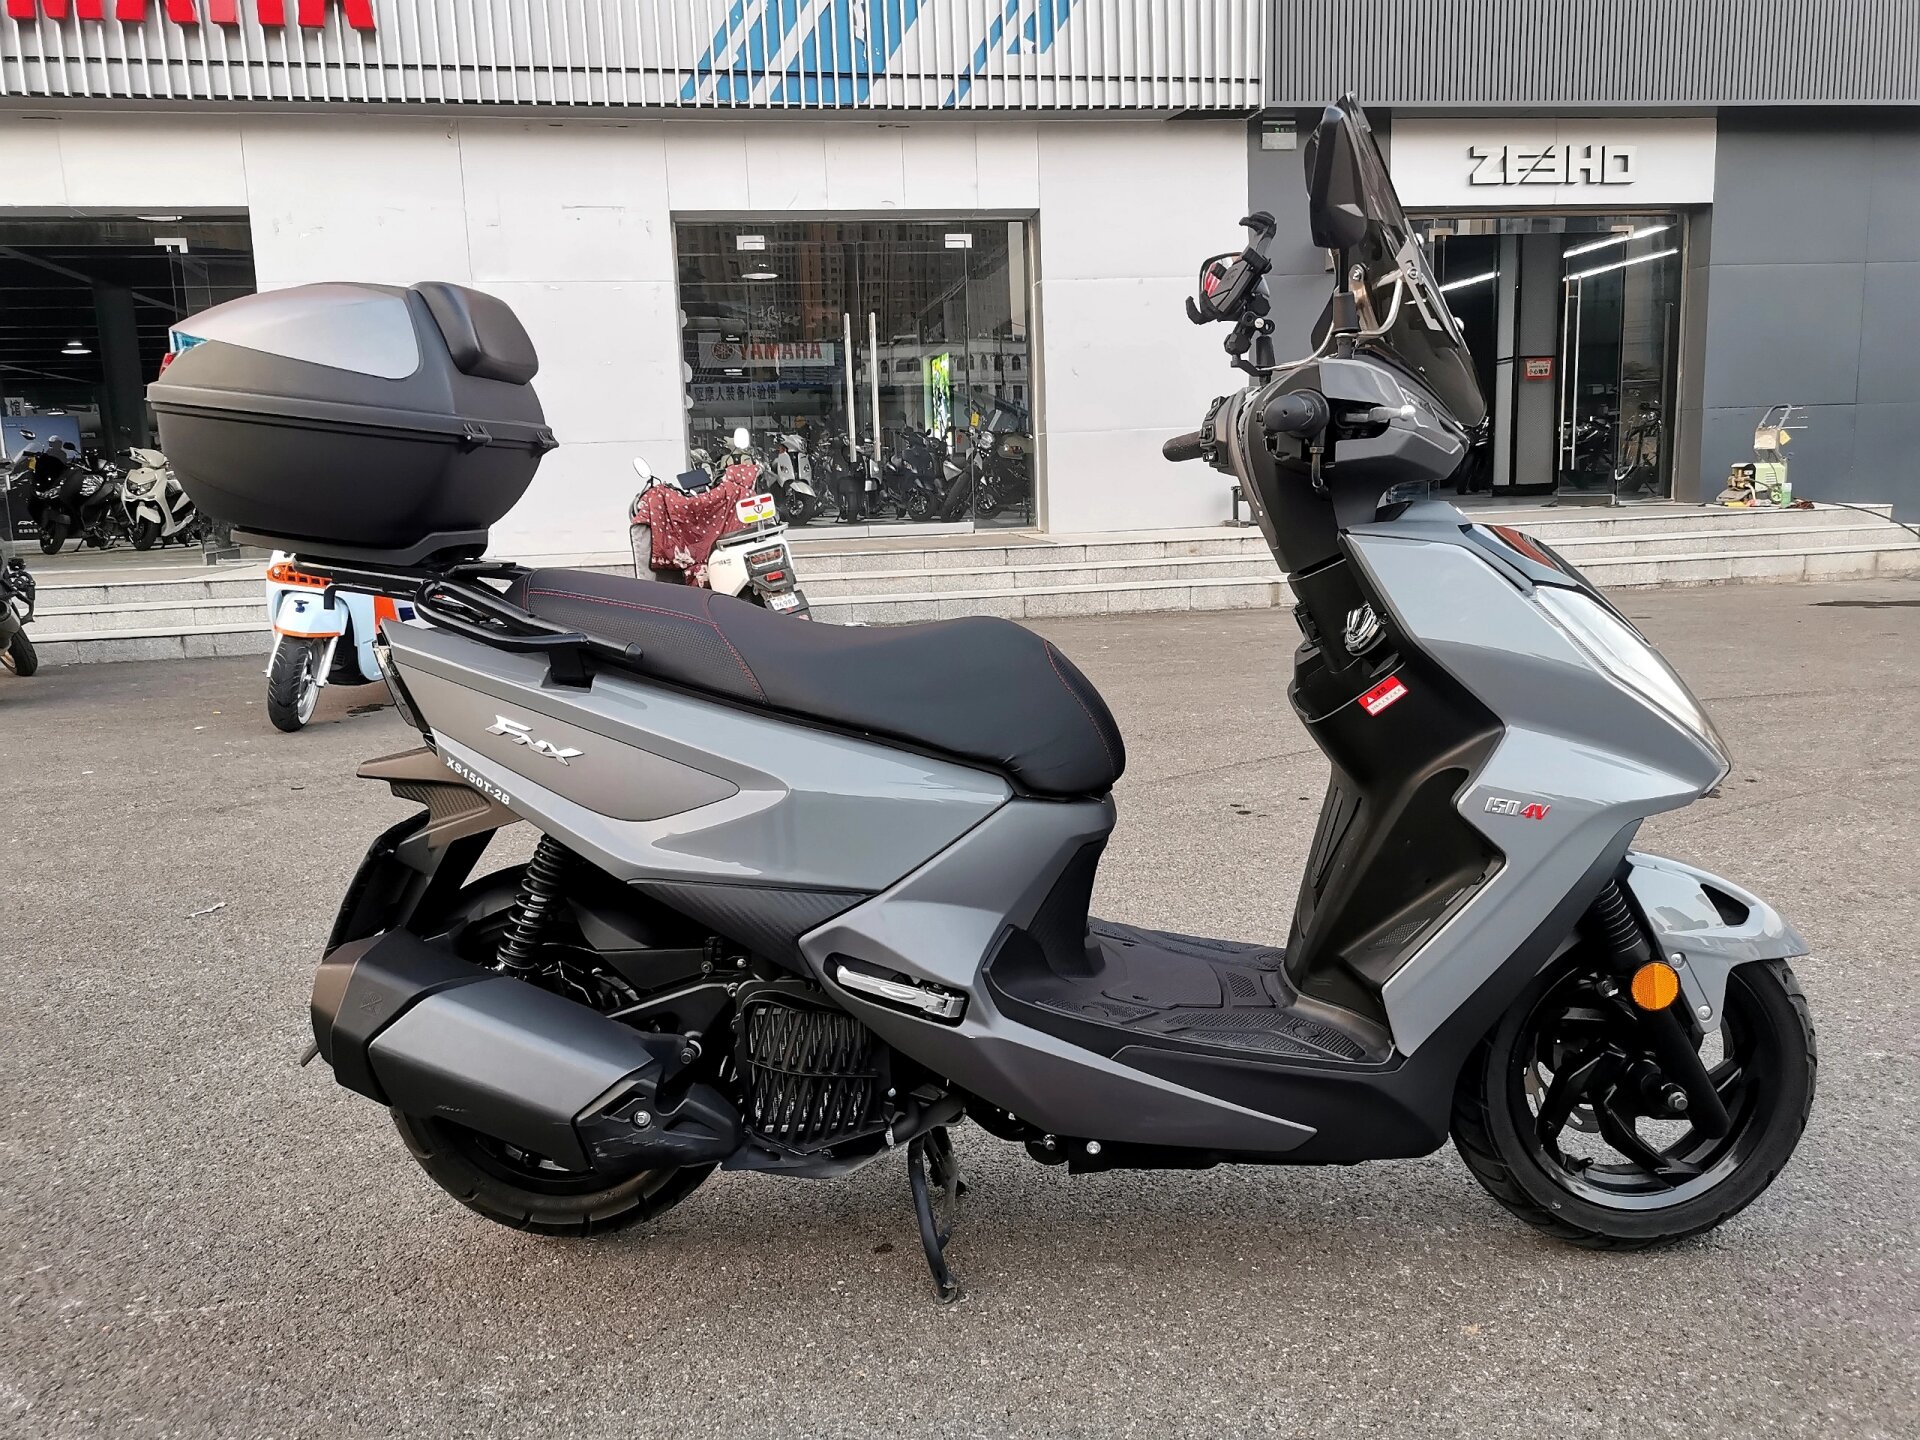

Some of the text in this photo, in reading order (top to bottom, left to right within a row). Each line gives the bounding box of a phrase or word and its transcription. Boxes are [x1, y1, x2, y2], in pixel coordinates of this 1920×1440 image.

[1468, 144, 1637, 186] ZEEHO
[740, 343, 823, 360] YAMAHA
[446, 756, 511, 805] XS150T-2B
[1484, 796, 1552, 821] 150 4V
